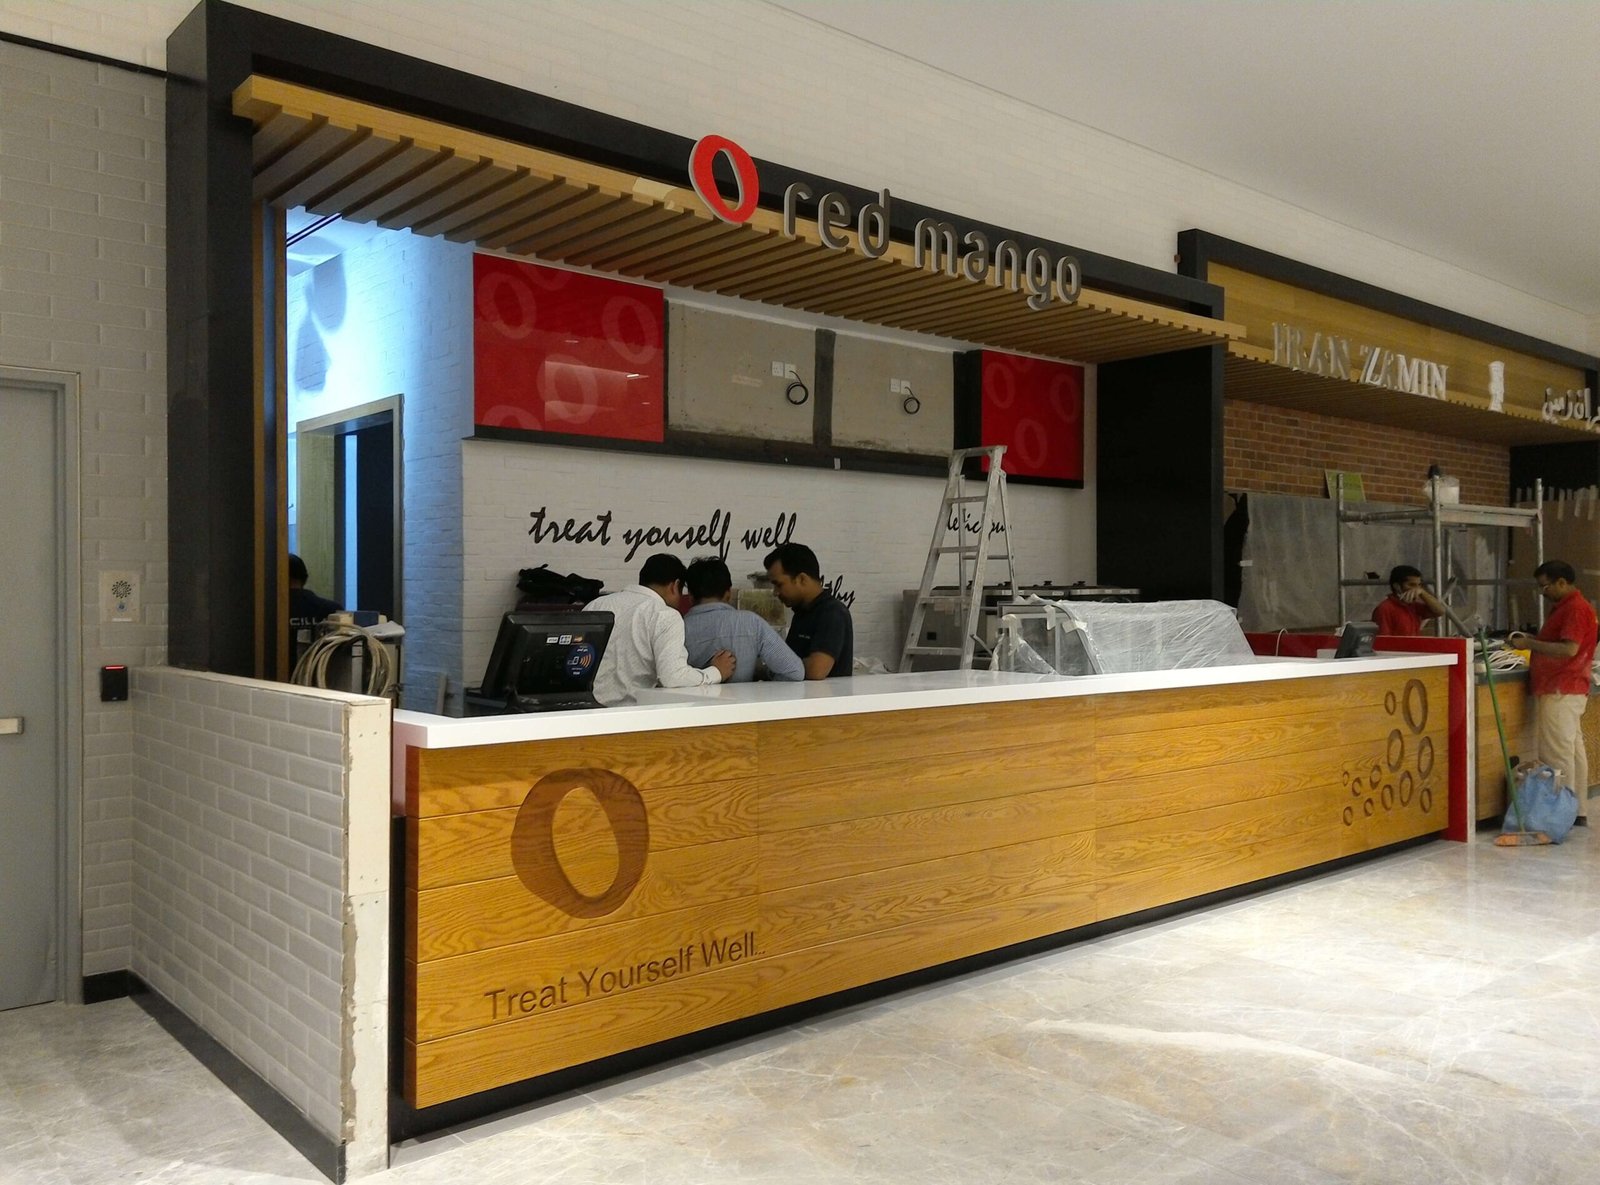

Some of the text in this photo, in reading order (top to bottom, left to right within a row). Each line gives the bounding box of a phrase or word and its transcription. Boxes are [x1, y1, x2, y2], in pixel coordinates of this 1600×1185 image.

[783, 181, 891, 259] red
[914, 217, 1082, 311] mango
[1271, 321, 1449, 401] IRAN ZAMIN
[528, 506, 613, 546] treat
[740, 511, 797, 550] well
[483, 976, 568, 1020] Treat
[577, 944, 695, 998] Yourself
